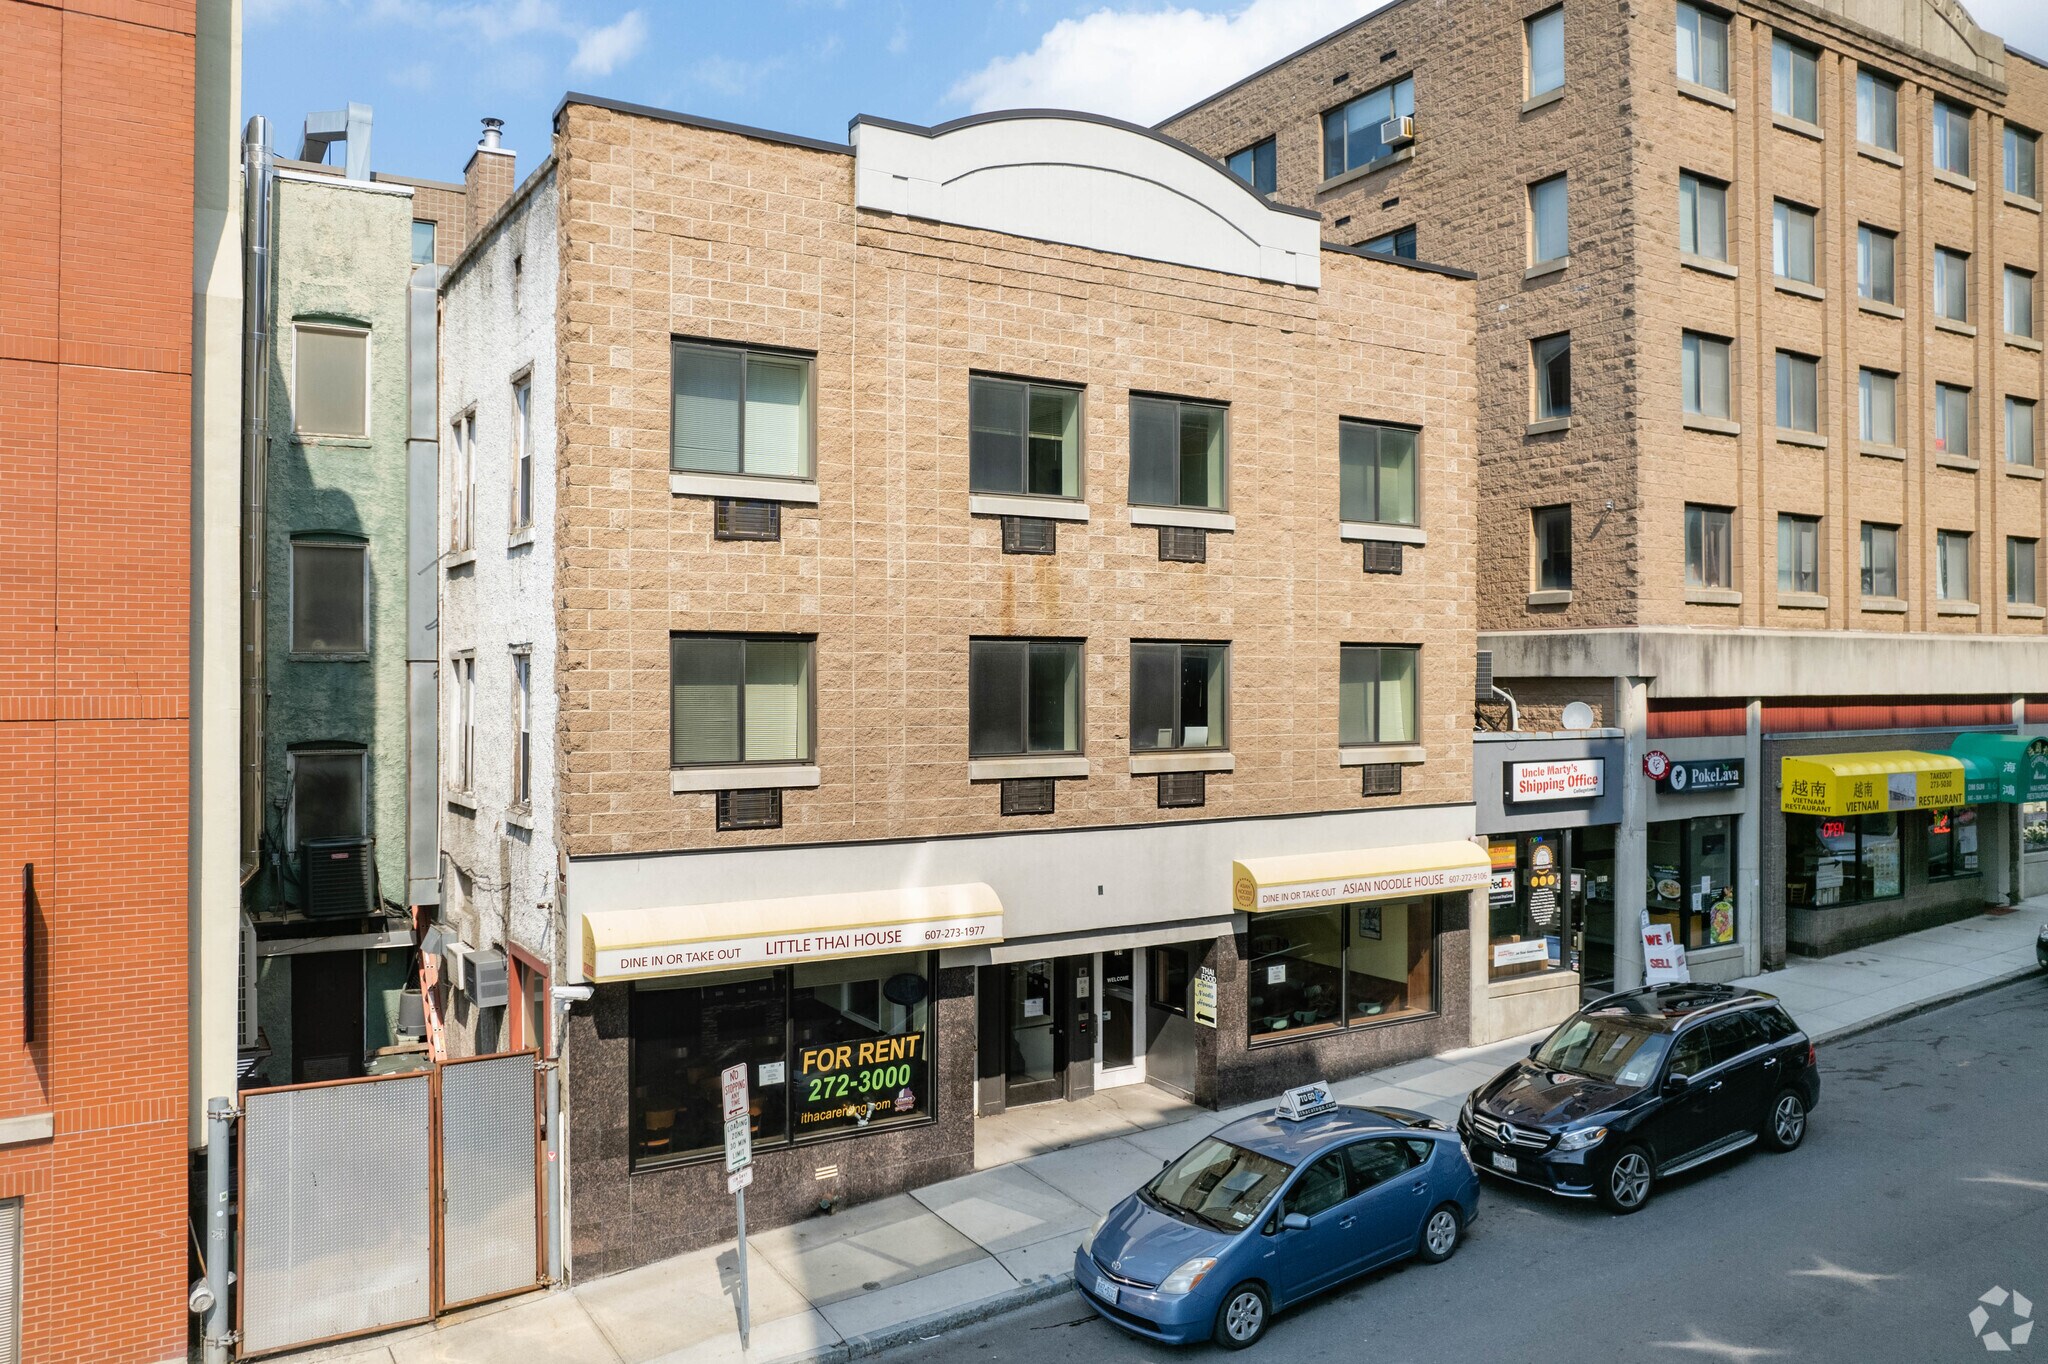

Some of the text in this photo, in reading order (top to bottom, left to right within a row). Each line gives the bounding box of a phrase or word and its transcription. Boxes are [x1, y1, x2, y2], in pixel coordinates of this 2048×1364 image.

[1521, 764, 1578, 778] Uncle Marty's
[1691, 767, 1739, 784] PokeLava
[1930, 771, 1952, 780] TAKEOUT
[1519, 774, 1598, 794] Shipping Office
[1791, 779, 1827, 798] 越南
[1853, 780, 1873, 798] 越南
[1792, 797, 1826, 806] VIETNAM
[1845, 800, 1880, 812] VIETNAM
[1918, 793, 1963, 807] RESTAURANT
[1785, 803, 1831, 813] RESTAURANT
[1823, 822, 1845, 838] OPEN
[1342, 873, 1444, 895] ASIAN NOODLE HOUSE
[1262, 887, 1336, 904] DINE IN OR TAKE OUT
[924, 926, 986, 941] 607-273-1977
[1645, 934, 1663, 946] WE
[765, 930, 903, 956] LITTLE THAI HOUSE
[620, 947, 742, 969] DINE IN OR TAKE OUT
[1650, 958, 1672, 969] SELL
[1201, 966, 1215, 977] THAI
[1107, 975, 1130, 983] WELCOME
[1201, 973, 1217, 985] FOOD
[802, 1045, 852, 1075] FOR
[858, 1034, 921, 1066] RENT
[729, 1070, 739, 1082] NO
[807, 1064, 912, 1102] 272-3000
[724, 1079, 746, 1096] STOPPING
[731, 1091, 740, 1100] ANY
[731, 1097, 741, 1108] TIME
[727, 1118, 748, 1133] LOADING
[731, 1129, 744, 1140] ZONE
[730, 1139, 747, 1151] 30 MIN
[732, 1148, 745, 1160] LIMIT
